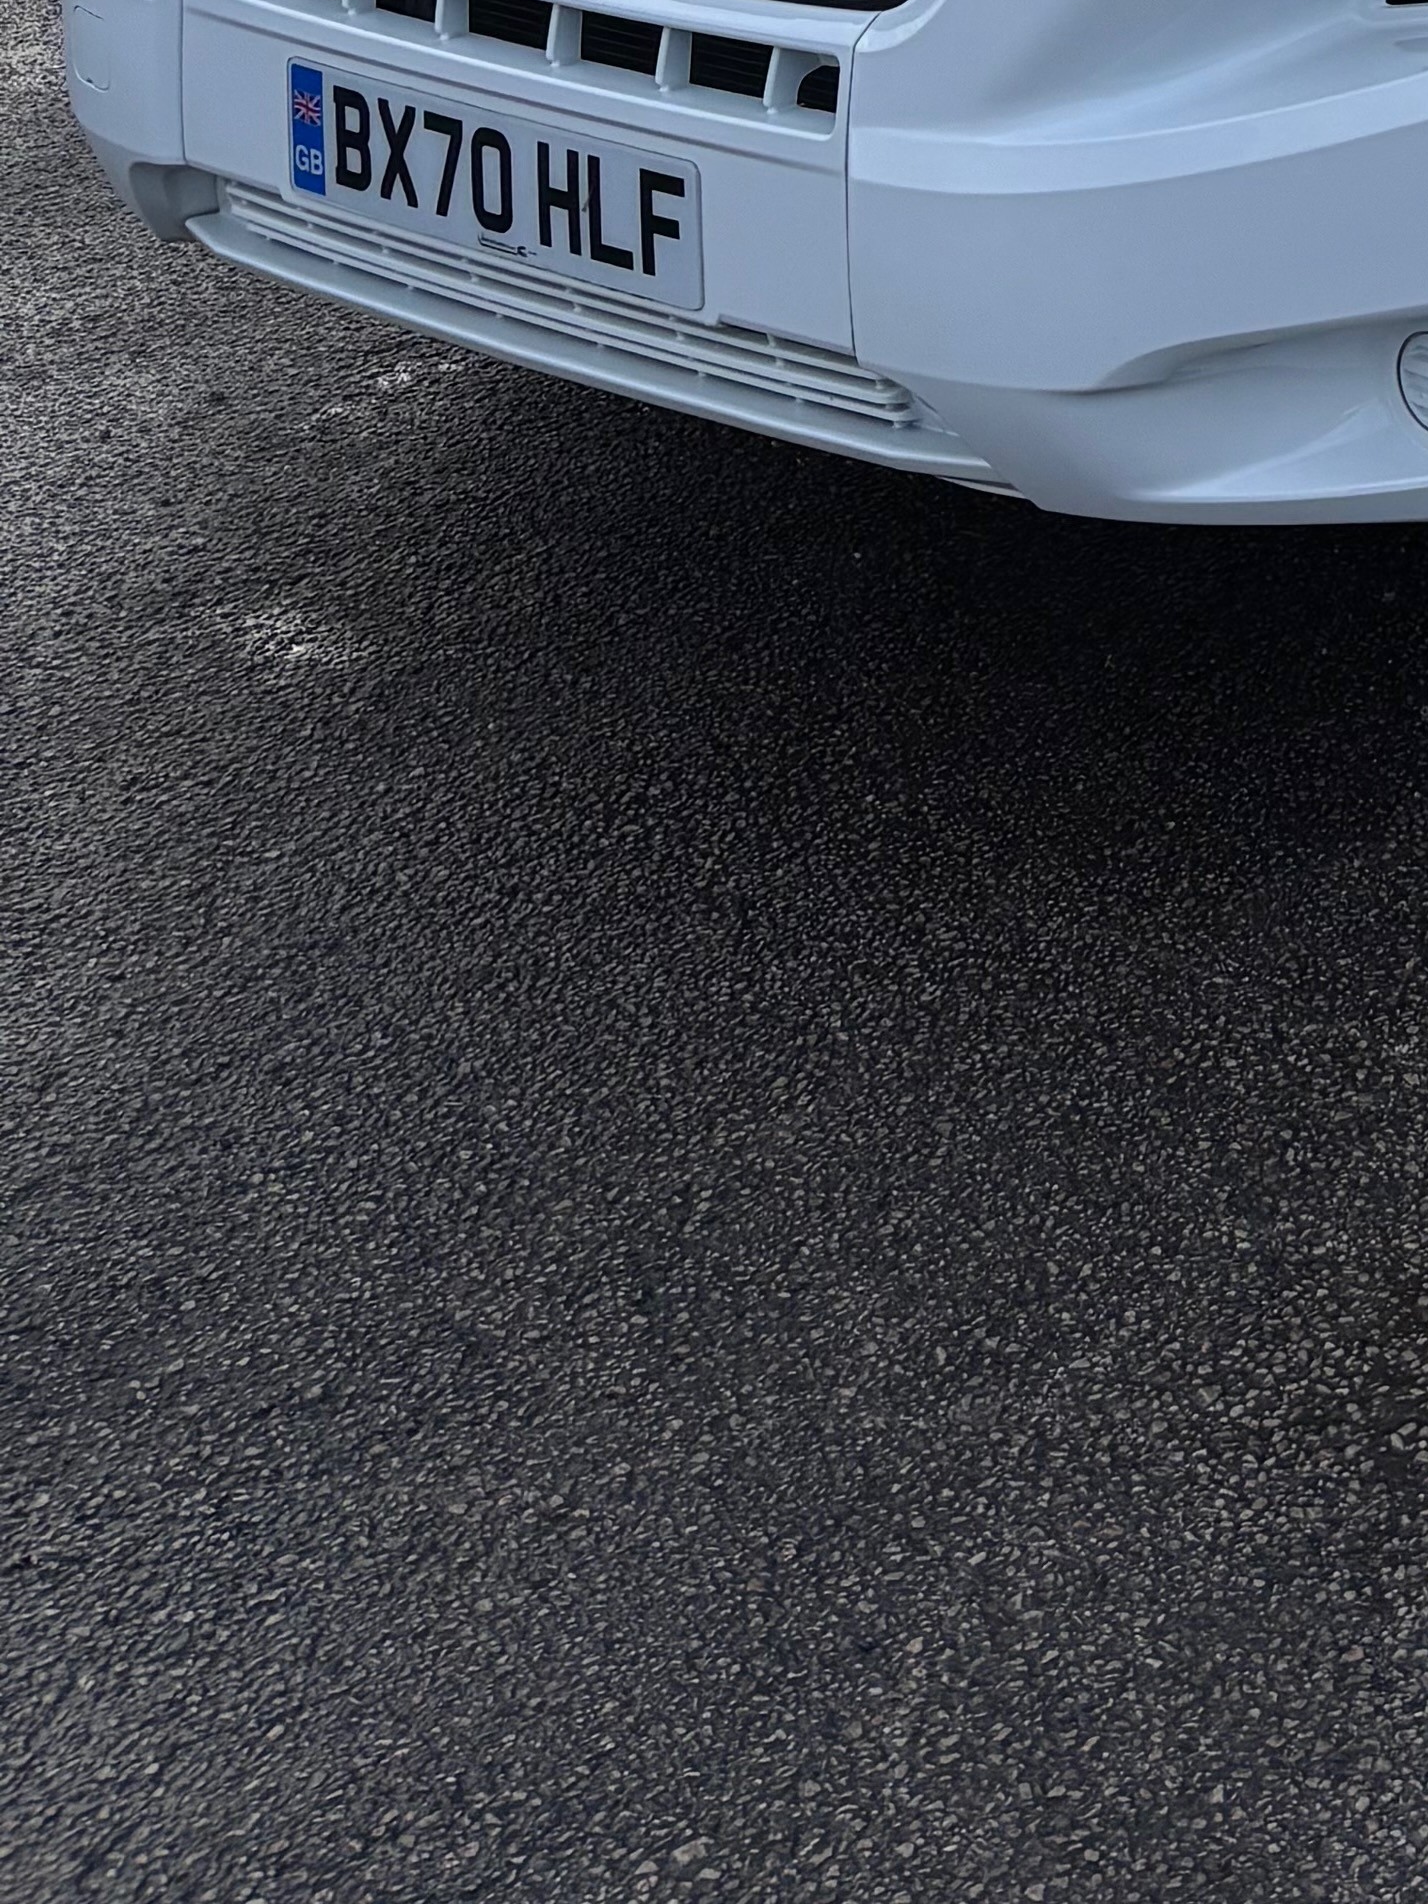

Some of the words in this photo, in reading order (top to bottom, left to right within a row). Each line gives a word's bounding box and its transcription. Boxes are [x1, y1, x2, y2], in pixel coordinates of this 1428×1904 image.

[295, 144, 323, 175] GB
[333, 85, 513, 233] BX70
[537, 141, 685, 276] HLF
